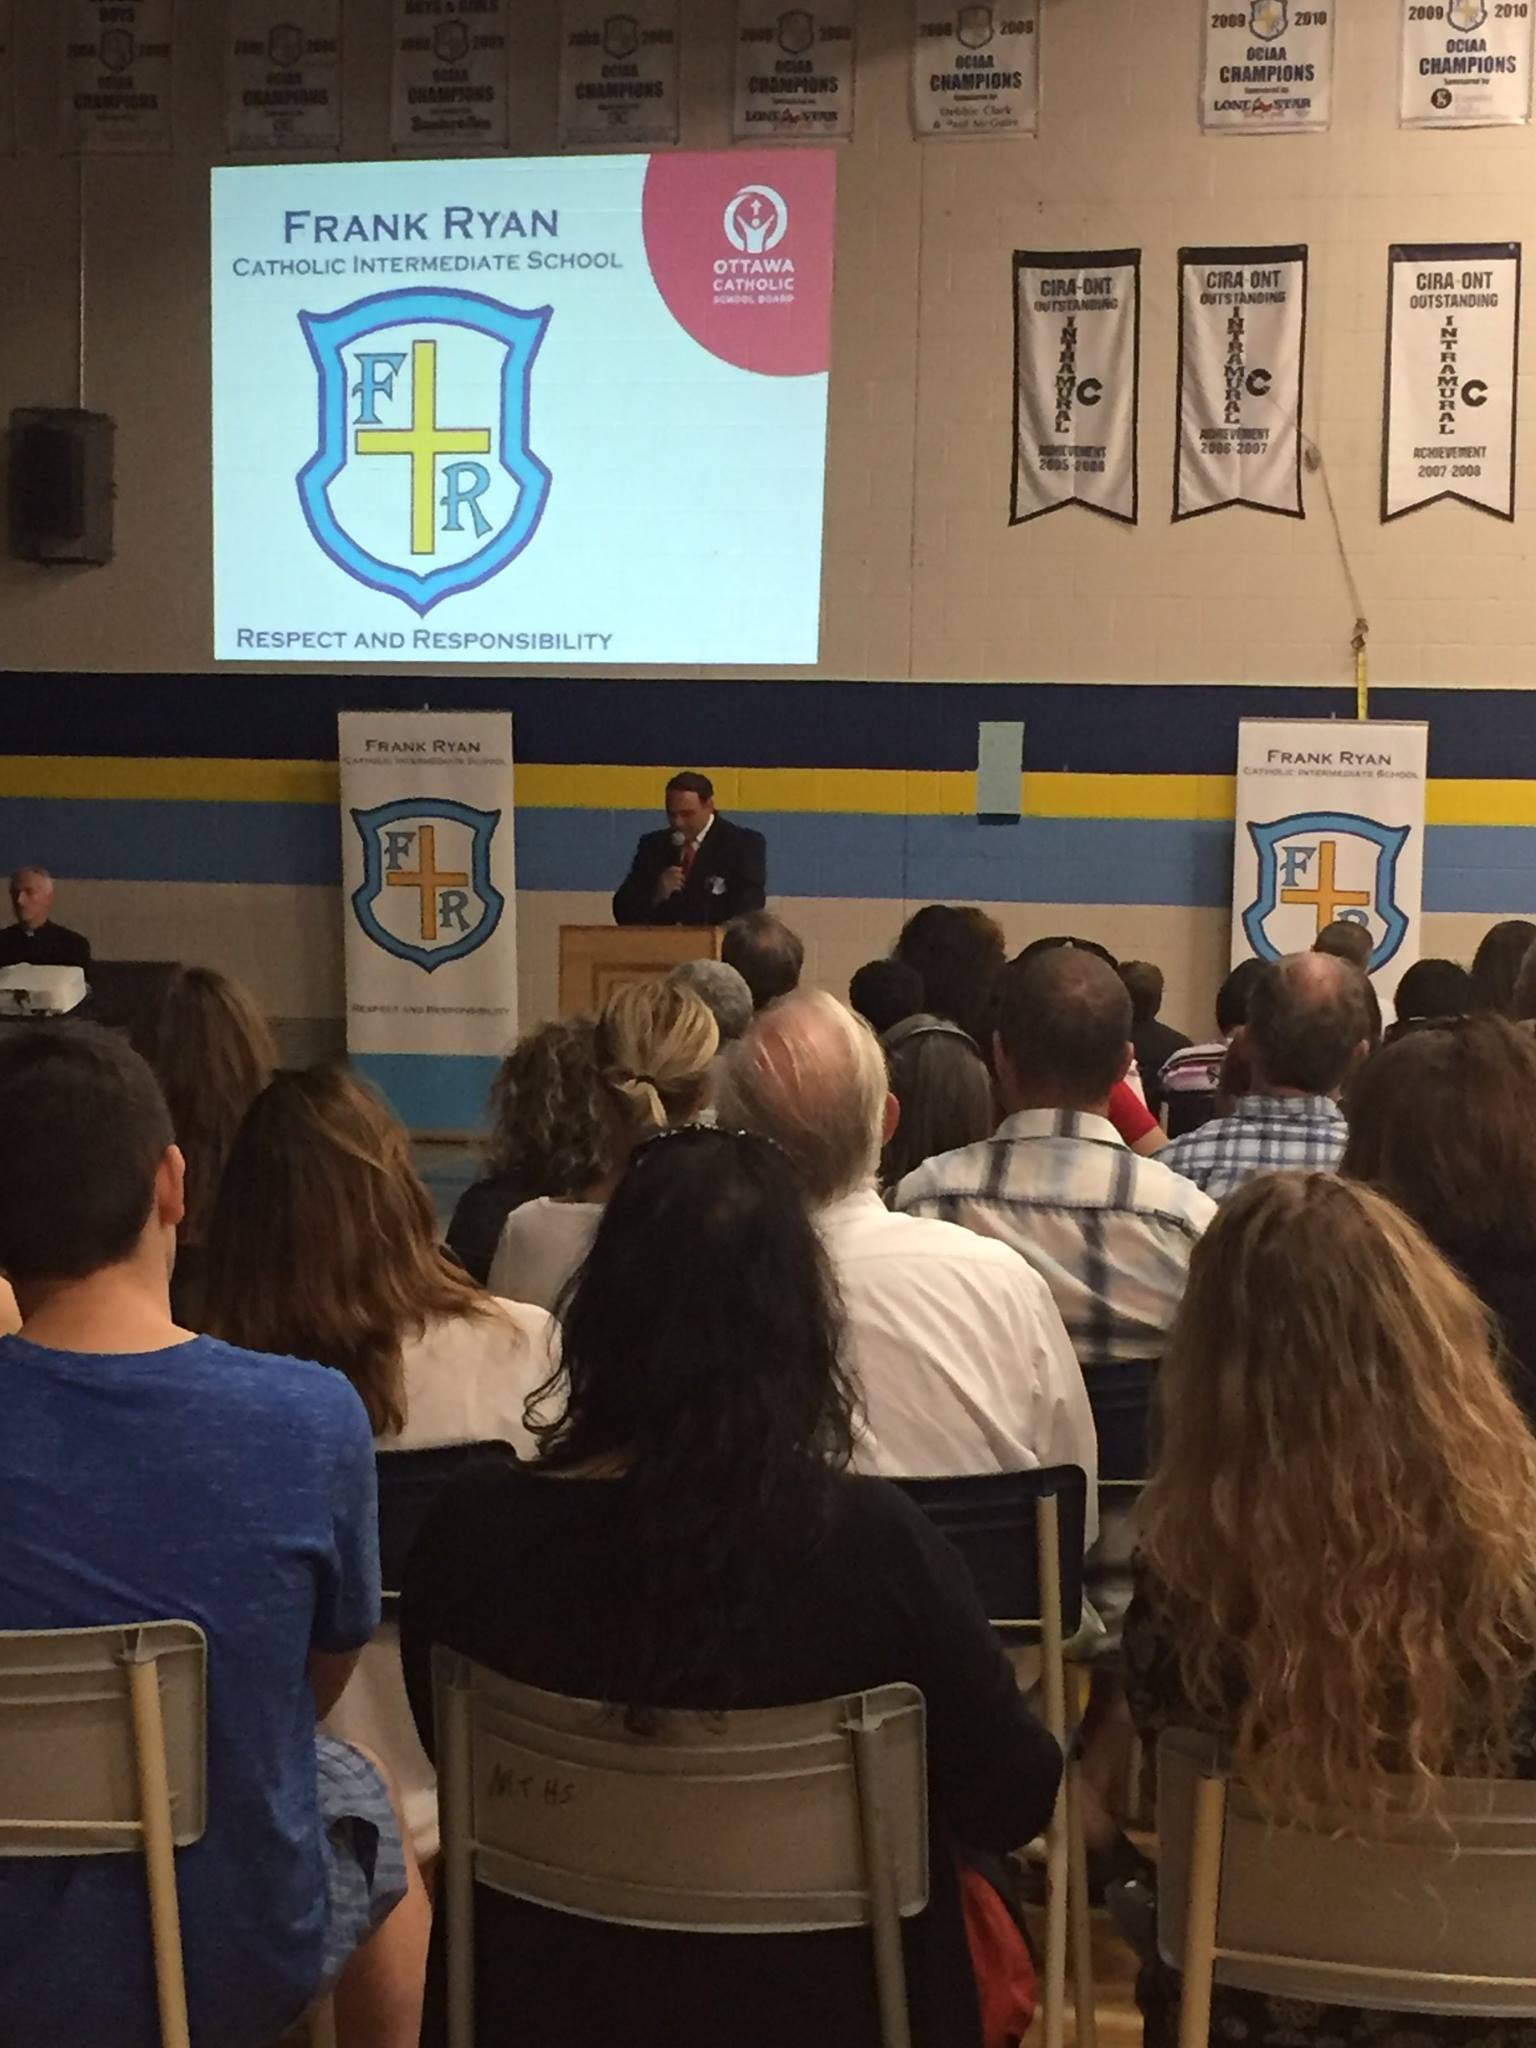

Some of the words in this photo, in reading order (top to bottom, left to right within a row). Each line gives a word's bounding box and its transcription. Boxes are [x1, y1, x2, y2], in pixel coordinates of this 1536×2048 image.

[1211, 13, 1245, 28] 2009
[1294, 11, 1327, 26] 2010
[1408, 6, 1443, 20] 2009
[1494, 4, 1528, 18] 2010
[1246, 46, 1287, 61] OCIAA
[1446, 38, 1487, 53] OCIAA
[1219, 64, 1314, 83] CHAMPIONS
[1419, 56, 1517, 76] CHAMPIONS
[748, 75, 838, 94] CHAMPIONS
[930, 72, 1022, 91] CHAMPIONS
[285, 210, 428, 244] FRANK
[444, 206, 559, 240] RYAN
[232, 257, 347, 277] CATHOLIC
[353, 253, 521, 274] INTERMEDIATE
[527, 250, 624, 270] SCHOOL
[713, 259, 795, 274] OTTAWA
[713, 278, 795, 292] CATHOLIC
[1034, 298, 1118, 312] OUTSTANDING
[1200, 291, 1286, 305] OUTSTANDING
[1410, 293, 1498, 309] OUTSTANDING
[1245, 368, 1272, 397] C
[1437, 315, 1458, 434] INTRAMURAL
[352, 352, 408, 425] F
[1076, 377, 1103, 406] C
[1461, 379, 1488, 407] C
[1413, 445, 1487, 459] ACHIEVEMENT
[440, 460, 494, 538] R
[236, 628, 347, 649] RESPECT
[354, 632, 406, 649] AND
[413, 629, 613, 651] RESPONSIBILITY
[365, 739, 426, 752] FRANK
[433, 739, 480, 752] RYAN
[1267, 750, 1332, 765] FRANK
[1340, 751, 1392, 765] RYAN
[1244, 766, 1293, 776] CATHOLIC
[1377, 769, 1418, 779] SCHOOL
[384, 831, 416, 870] F
[1280, 846, 1317, 887] F
[439, 890, 471, 931] R
